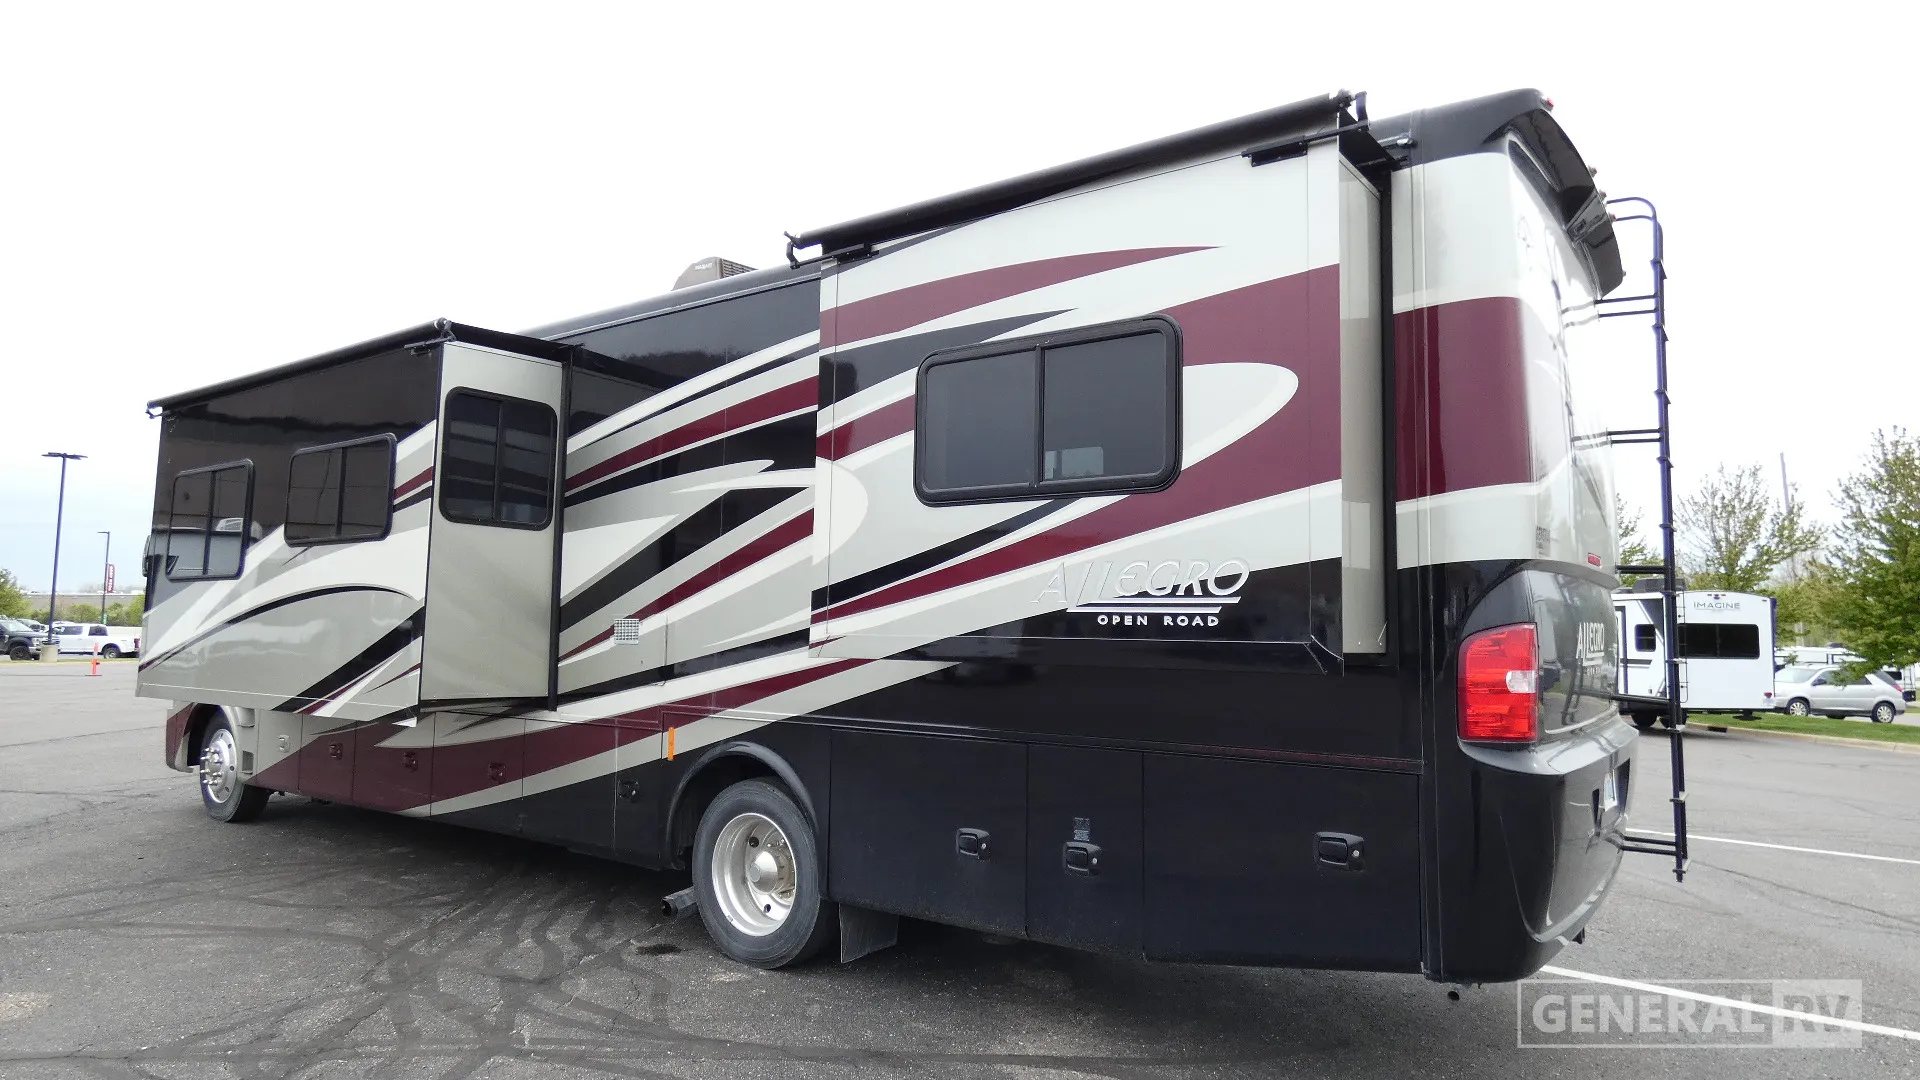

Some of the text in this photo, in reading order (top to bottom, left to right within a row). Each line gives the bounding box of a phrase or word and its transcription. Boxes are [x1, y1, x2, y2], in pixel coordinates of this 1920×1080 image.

[1031, 558, 1250, 611] ALLEGRO
[1693, 601, 1741, 610] IMAGINE
[1097, 614, 1220, 627] OPEN ROAD
